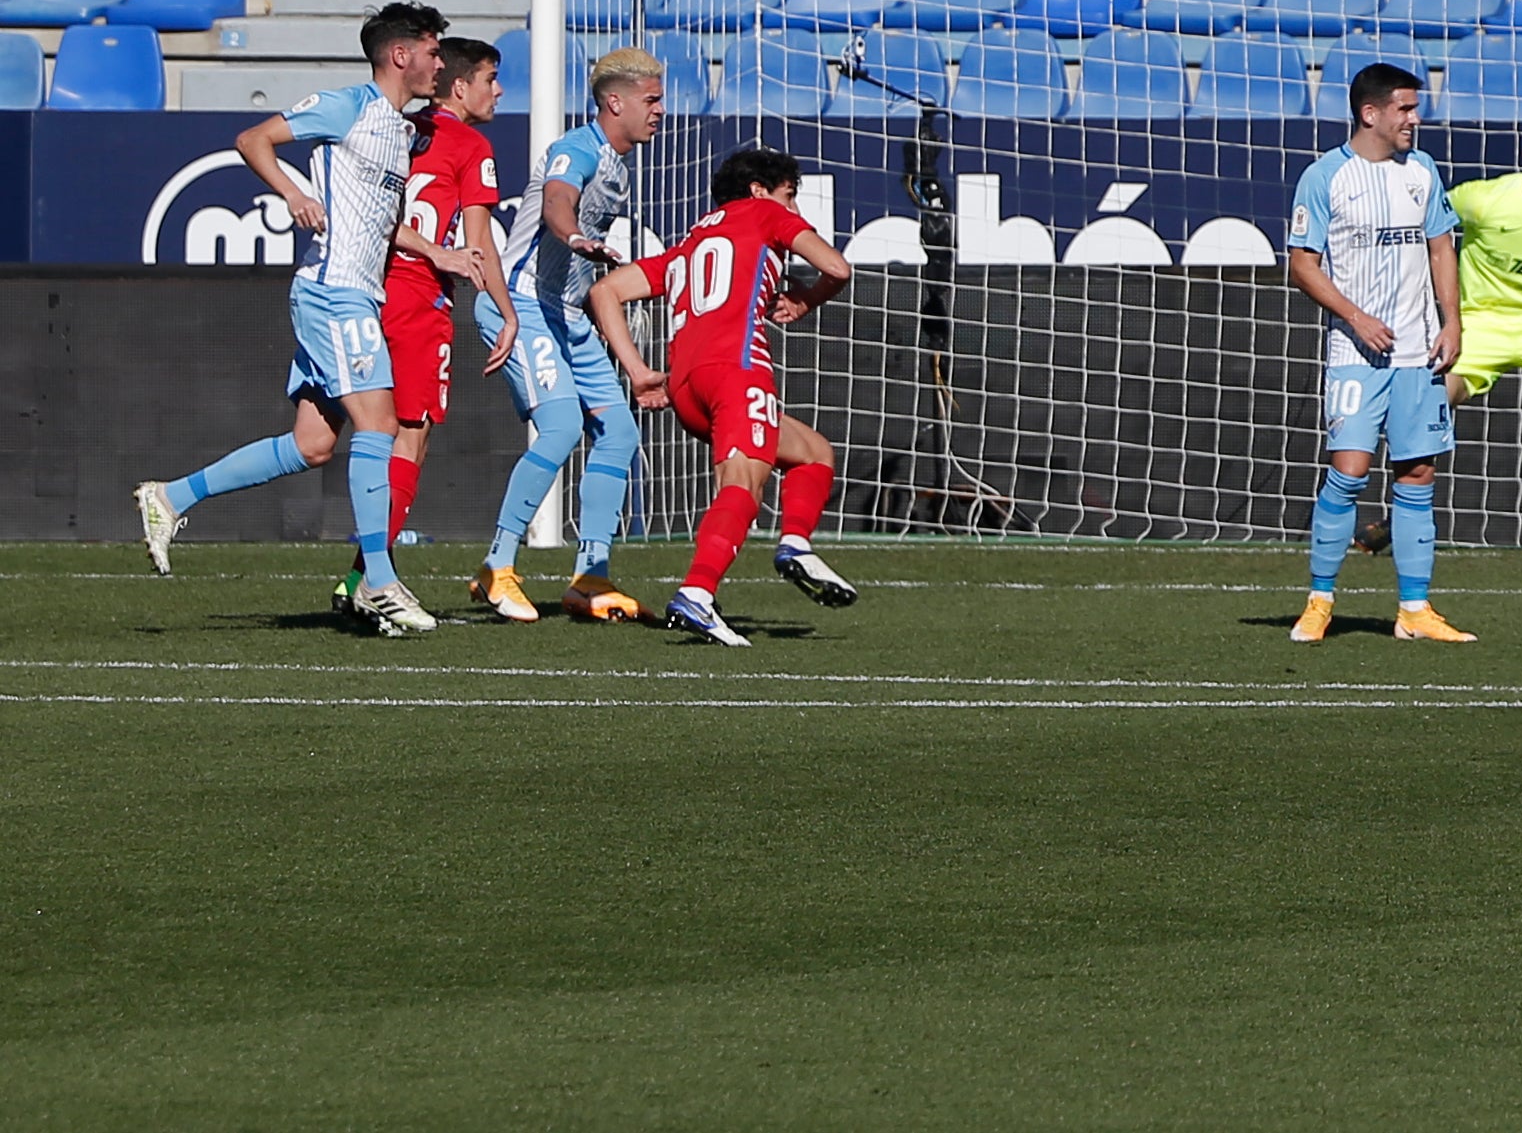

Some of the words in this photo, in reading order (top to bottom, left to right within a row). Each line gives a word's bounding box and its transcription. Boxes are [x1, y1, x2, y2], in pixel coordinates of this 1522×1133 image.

[665, 236, 735, 342] 20
[343, 316, 382, 355] 19
[532, 335, 558, 368] 2
[437, 342, 452, 381] 2
[745, 386, 779, 429] 20
[1328, 378, 1363, 416] 10
